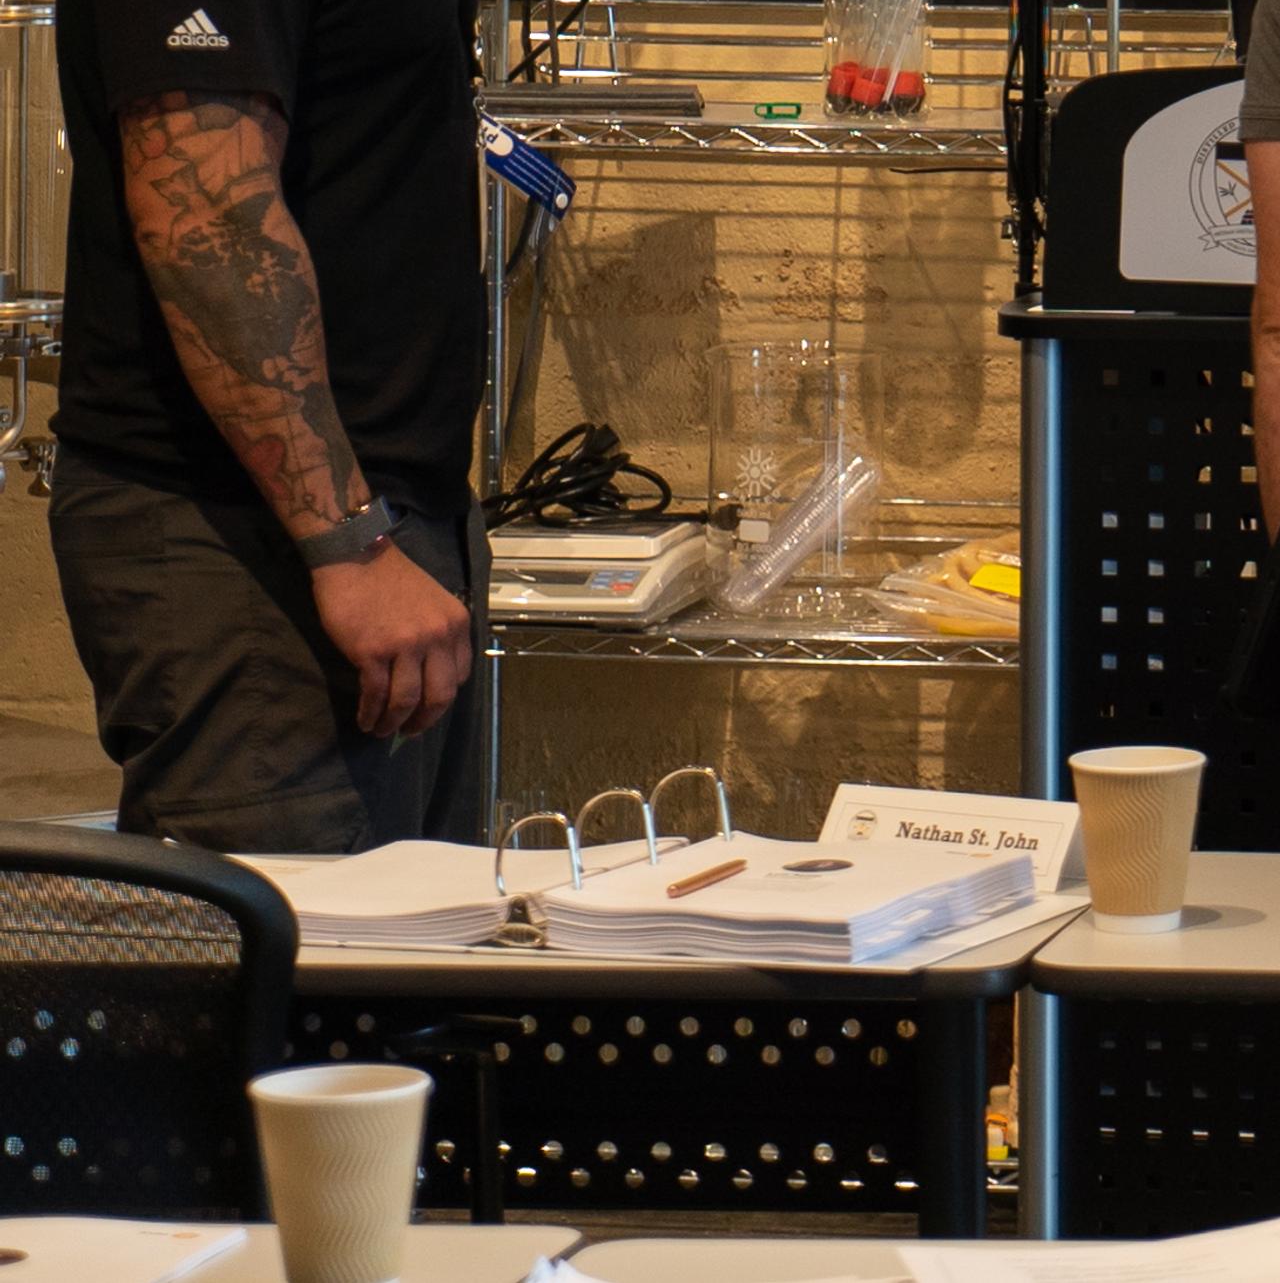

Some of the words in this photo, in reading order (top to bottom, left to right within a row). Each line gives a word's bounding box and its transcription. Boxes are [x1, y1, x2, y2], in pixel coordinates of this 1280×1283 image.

[167, 31, 229, 47] adidas
[1197, 122, 1236, 164] DISTILLED
[896, 821, 963, 844] Nathan
[968, 829, 990, 846] St.
[995, 832, 1039, 851] John
